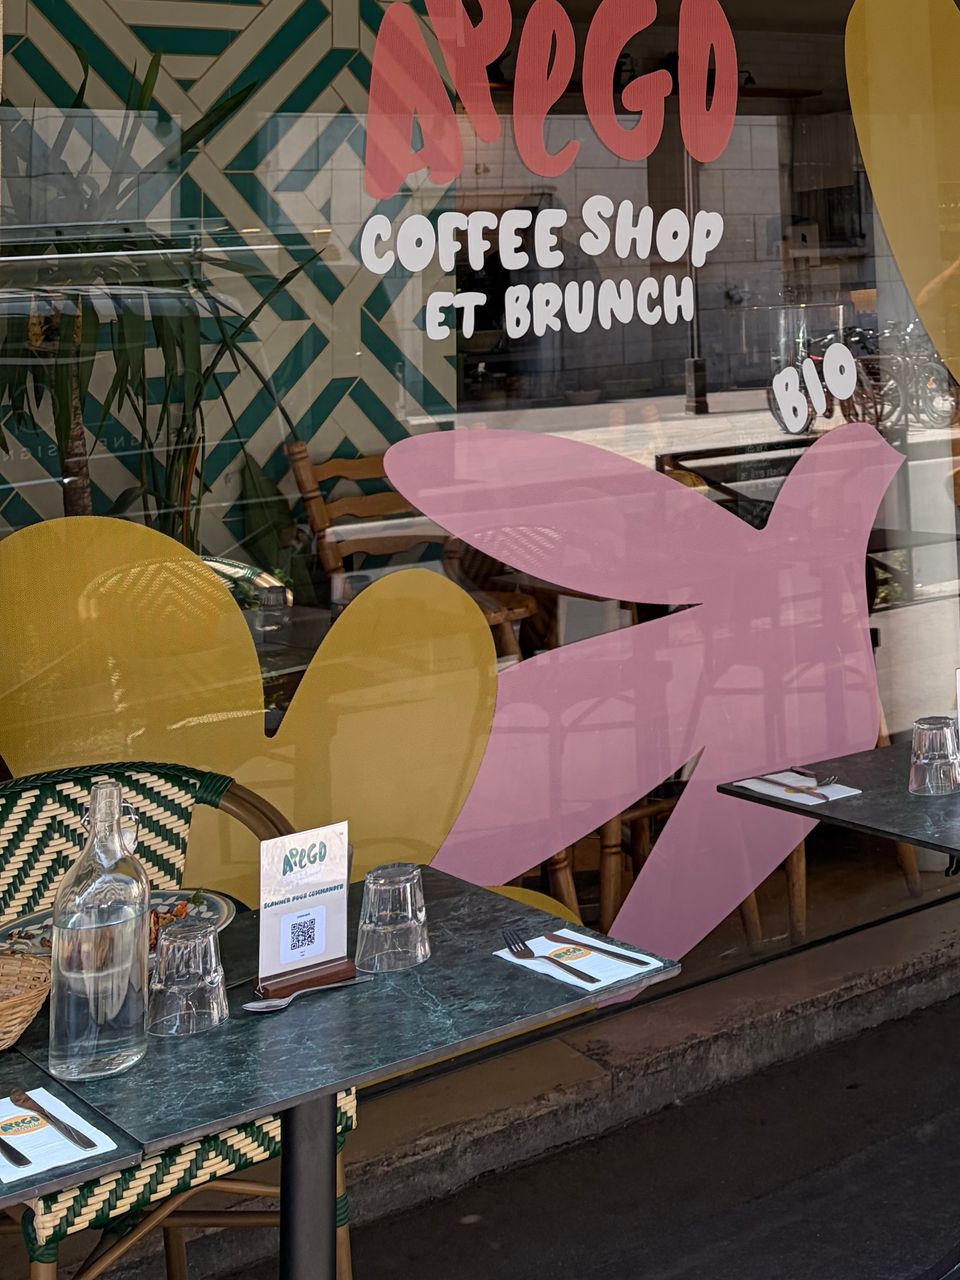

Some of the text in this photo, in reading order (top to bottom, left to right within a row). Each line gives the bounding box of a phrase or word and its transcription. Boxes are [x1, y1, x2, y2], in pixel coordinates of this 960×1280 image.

[360, 194, 724, 275] COFFEE SHOP
[425, 274, 694, 340] ET BRUNCH
[772, 342, 857, 434] BIO
[292, 893, 308, 902] POUR
